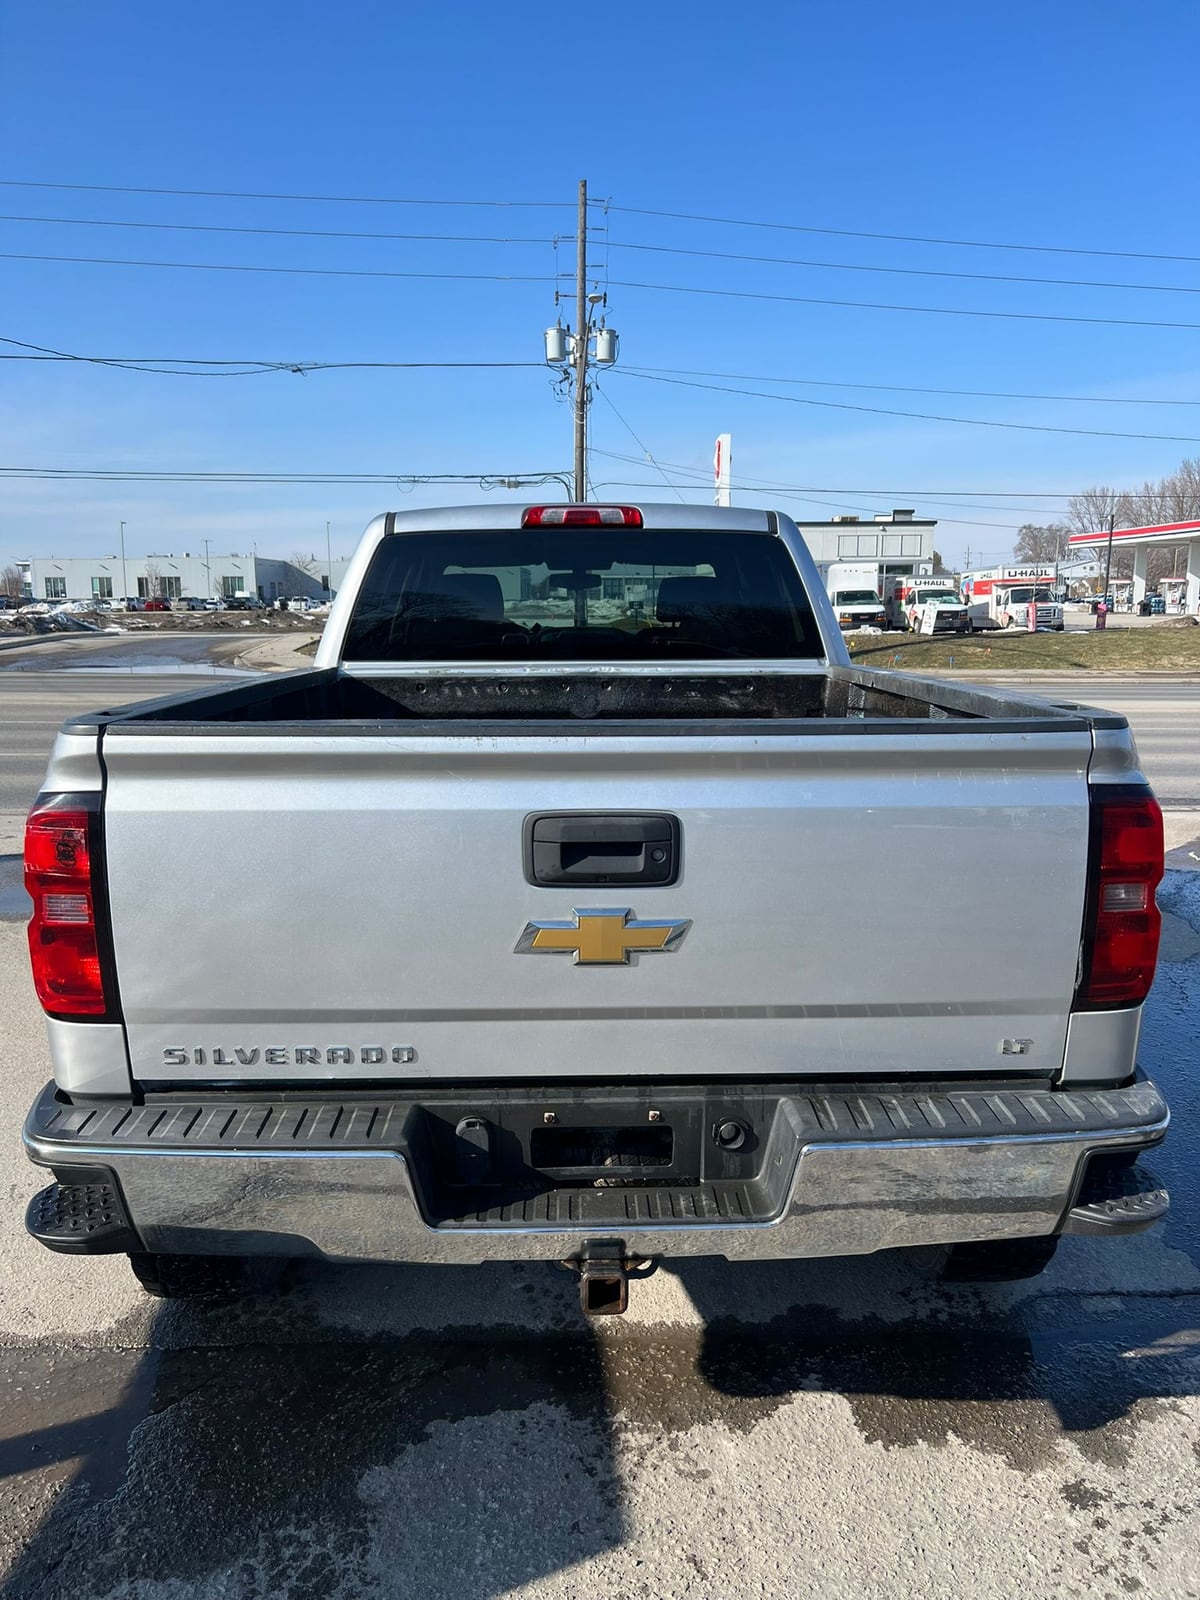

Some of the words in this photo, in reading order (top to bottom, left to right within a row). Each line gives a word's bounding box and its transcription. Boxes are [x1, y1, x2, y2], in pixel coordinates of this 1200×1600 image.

[1008, 569, 1050, 577] U-HAUL
[163, 1045, 416, 1065] SILVERADO
[1001, 1039, 1033, 1055] LT
